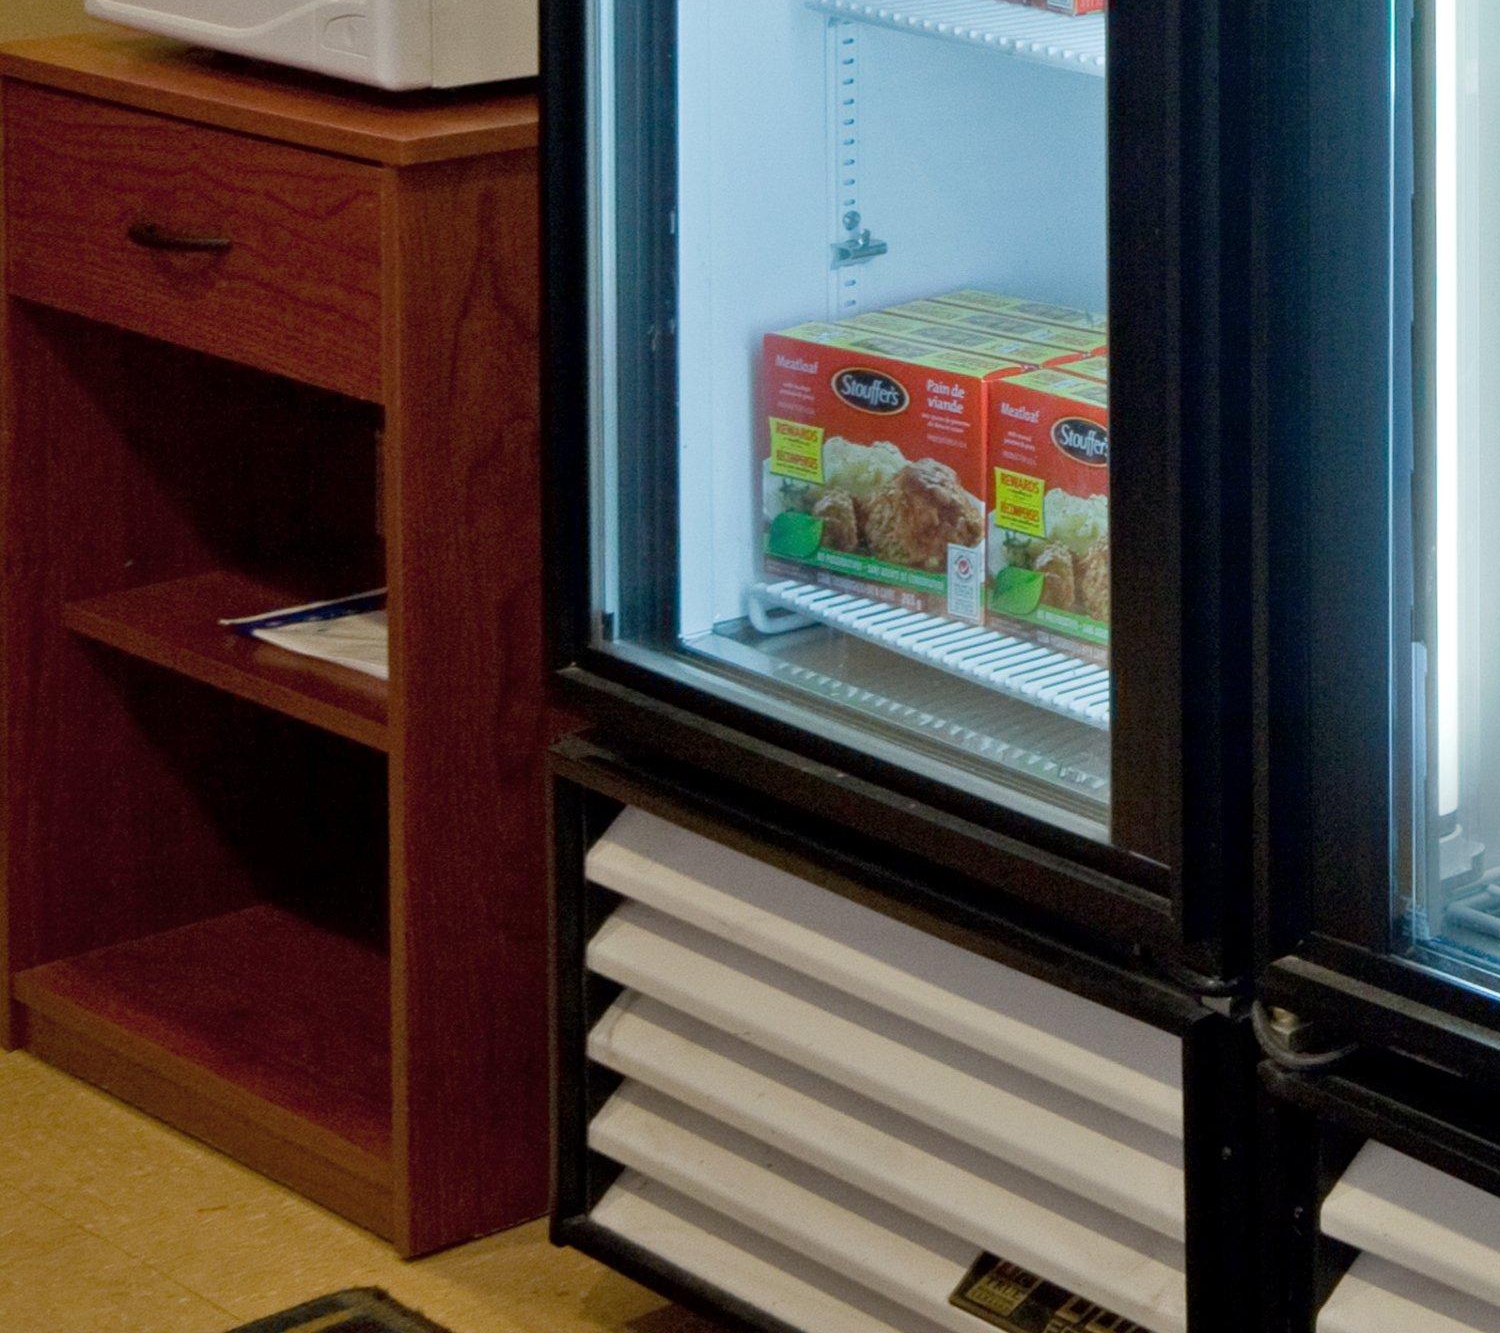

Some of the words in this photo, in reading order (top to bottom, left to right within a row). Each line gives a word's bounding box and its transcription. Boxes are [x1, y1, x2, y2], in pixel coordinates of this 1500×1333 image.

[842, 375, 899, 405] Stouffer's
[926, 380, 949, 395] Pain
[952, 384, 965, 398] de
[926, 396, 964, 414] viande
